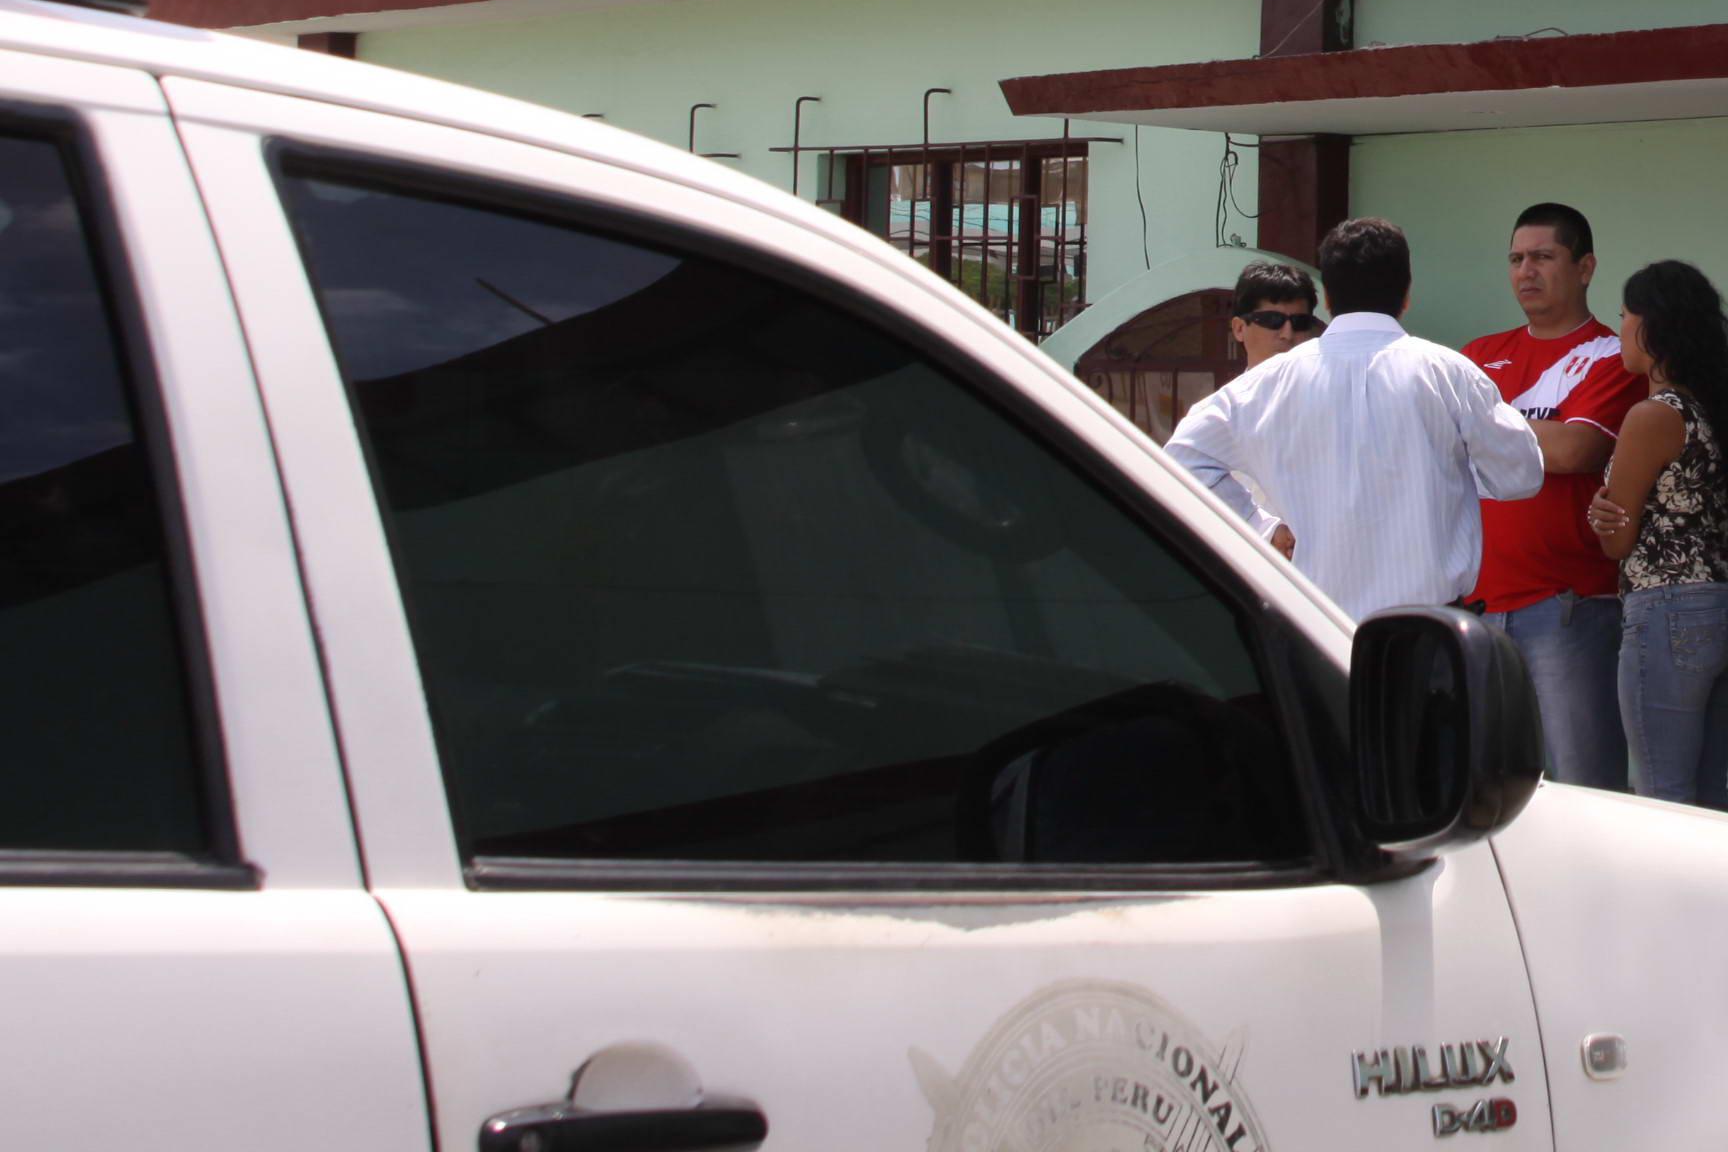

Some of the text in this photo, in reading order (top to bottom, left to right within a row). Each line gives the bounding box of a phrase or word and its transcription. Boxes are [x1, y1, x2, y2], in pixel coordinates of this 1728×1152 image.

[1352, 1034, 1515, 1099] HILUX
[1093, 1076, 1174, 1126] PERU
[1432, 1097, 1517, 1138] D-4D
